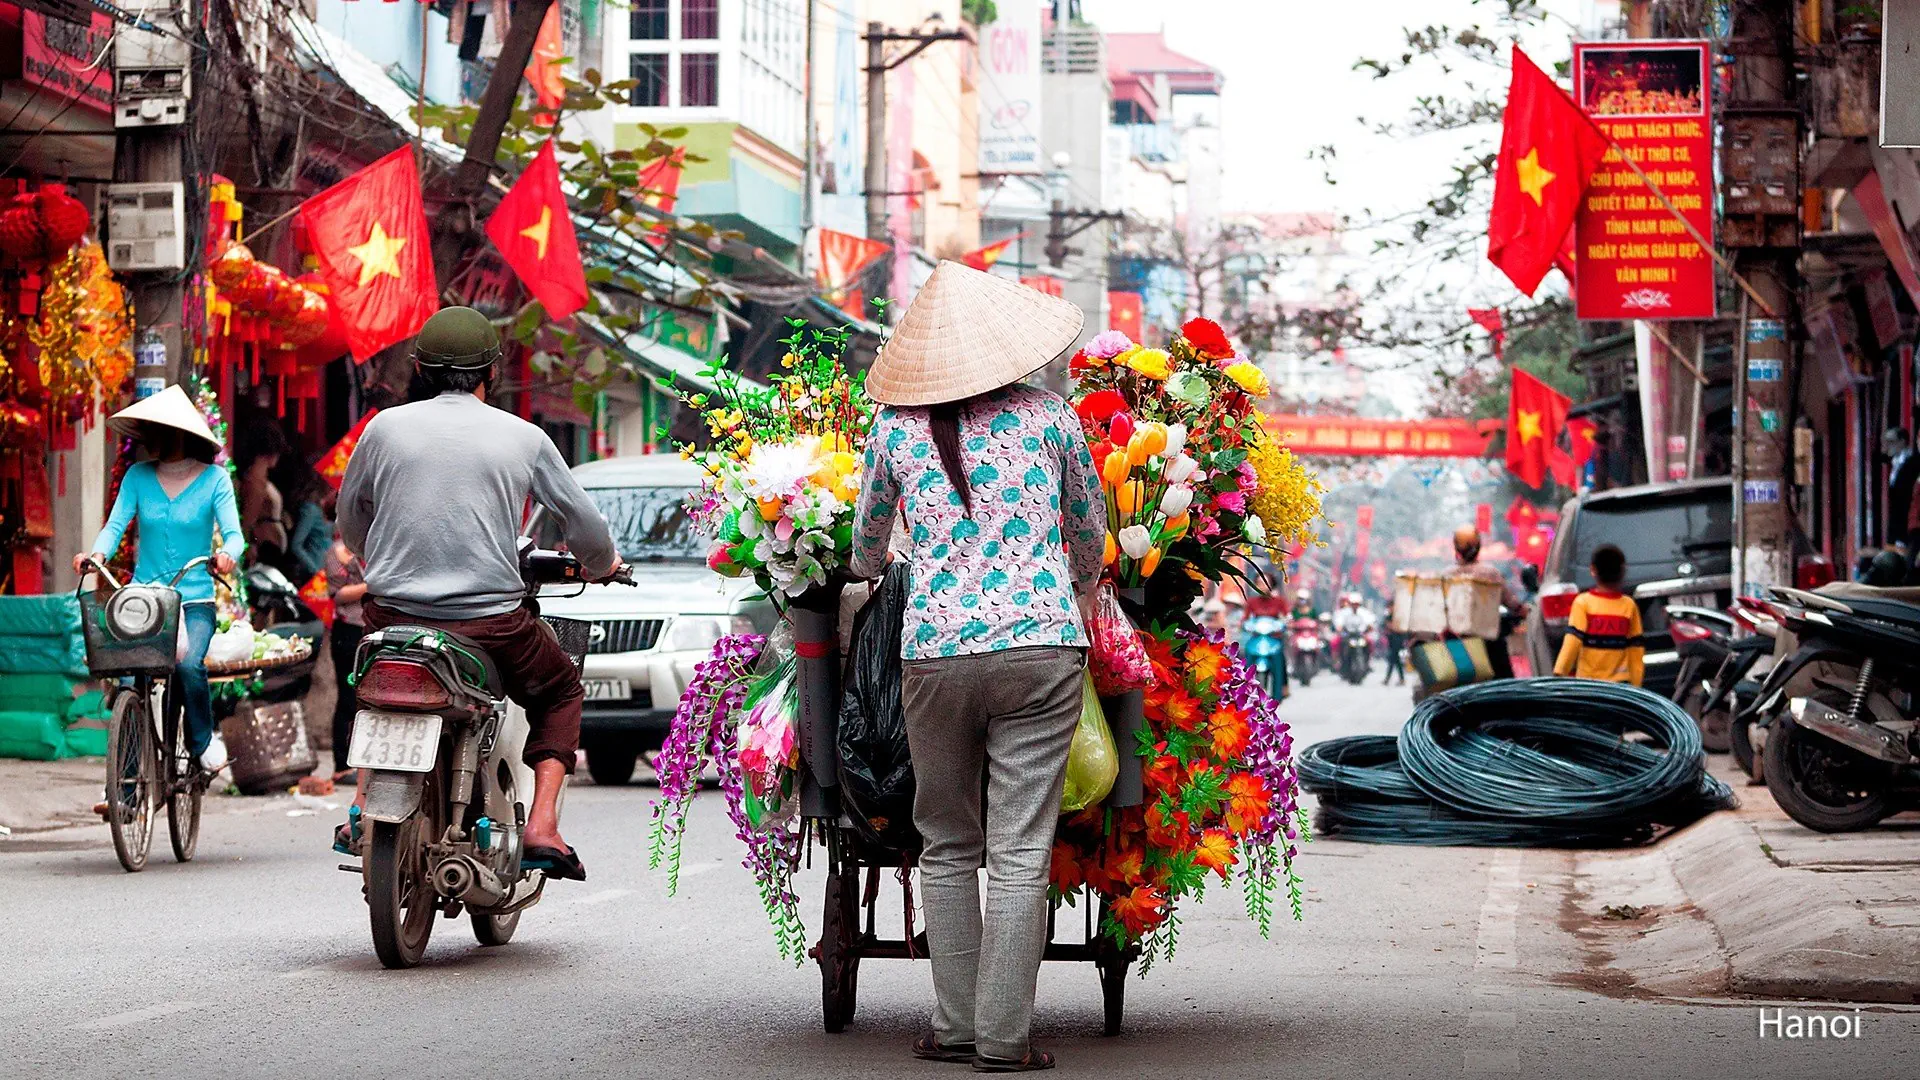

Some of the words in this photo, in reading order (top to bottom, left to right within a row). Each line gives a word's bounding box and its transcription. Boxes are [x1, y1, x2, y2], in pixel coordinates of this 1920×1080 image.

[1612, 124, 1634, 139] QUA
[1632, 219, 1657, 235] NAM
[1640, 268, 1668, 282] MINH
[366, 715, 428, 741] 33-P9
[361, 741, 422, 767] 4336
